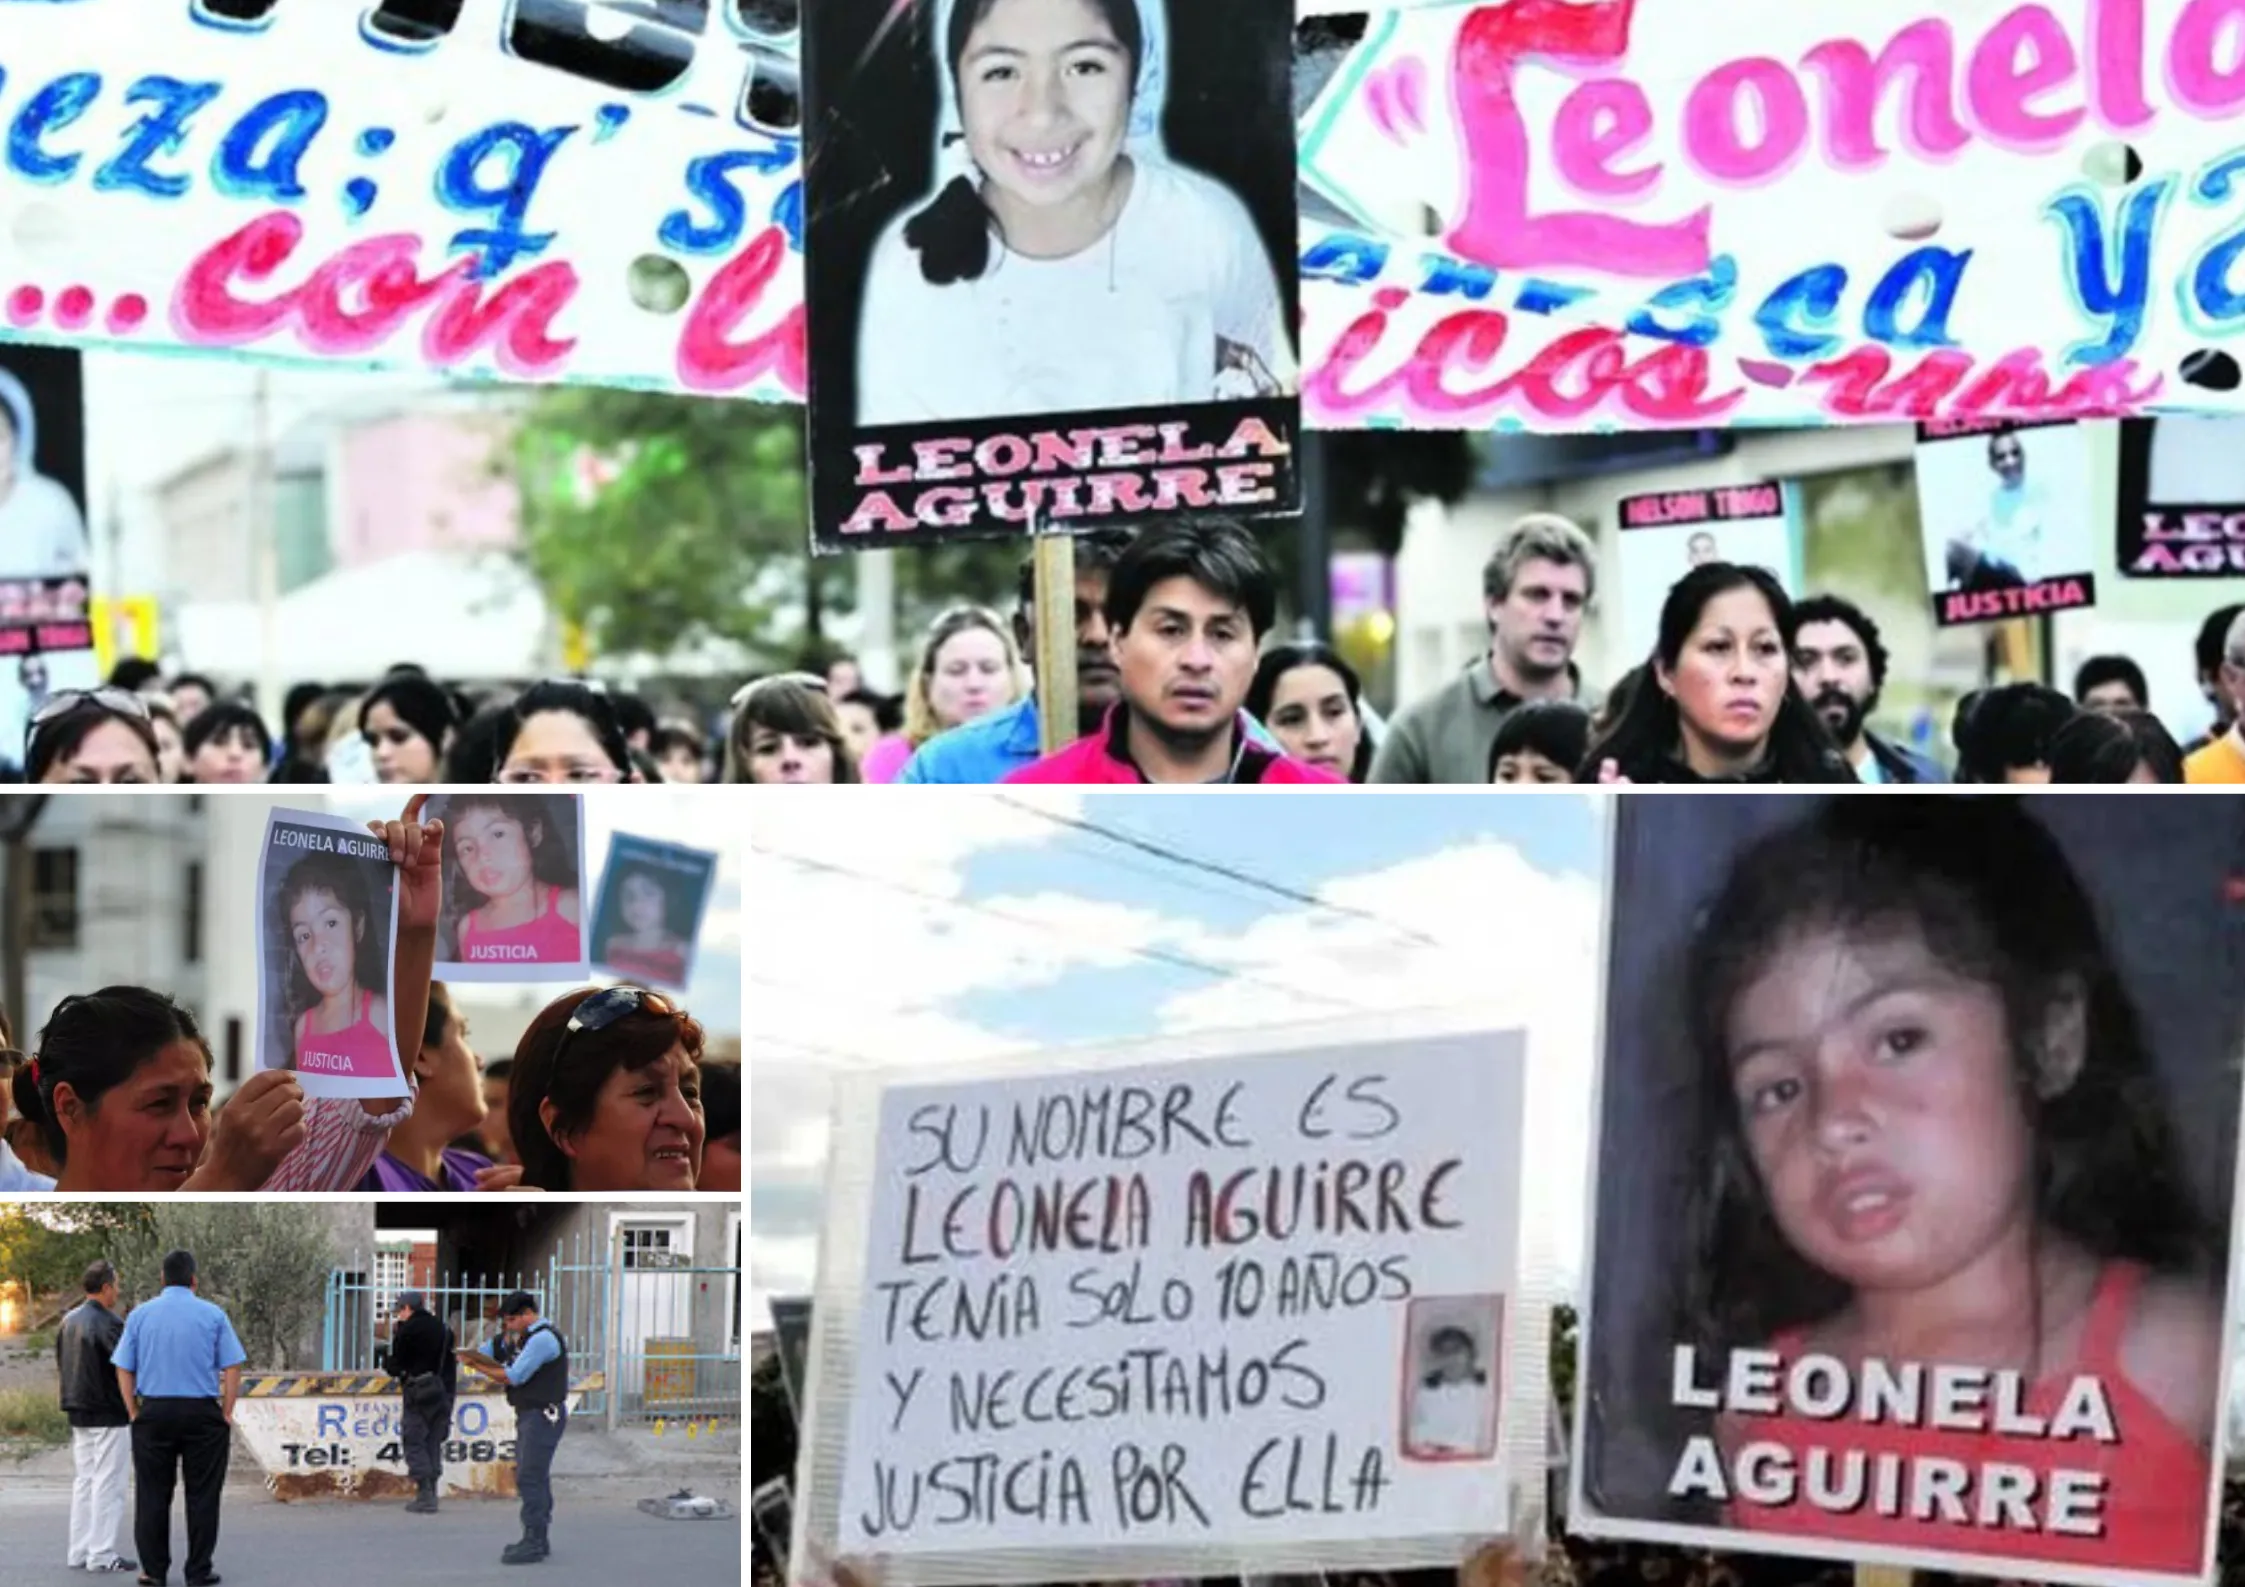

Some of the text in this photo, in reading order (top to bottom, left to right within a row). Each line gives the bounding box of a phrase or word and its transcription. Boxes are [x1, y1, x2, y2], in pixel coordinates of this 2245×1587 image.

[854, 416, 1291, 485] LEONELA
[839, 462, 1276, 534] AGUIRRE
[1944, 579, 2086, 620] JUSTICIA
[273, 829, 334, 852] LEONELA
[469, 944, 538, 960] JUSTICIA
[302, 1050, 354, 1072] JUSTICIA
[905, 1073, 1402, 1176] SU NOMBRE ES
[901, 1171, 1151, 1265] LEONELA
[1215, 1260, 1264, 1322] 10
[1277, 1253, 1412, 1318] AÑOS
[885, 1367, 923, 1432] Y
[1671, 1344, 2118, 1445] LEONELA
[281, 1443, 350, 1466] Tel:
[1112, 1443, 1212, 1530] POR
[1239, 1432, 1392, 1518] ELLA
[1668, 1436, 2109, 1537] AGUIRRE
